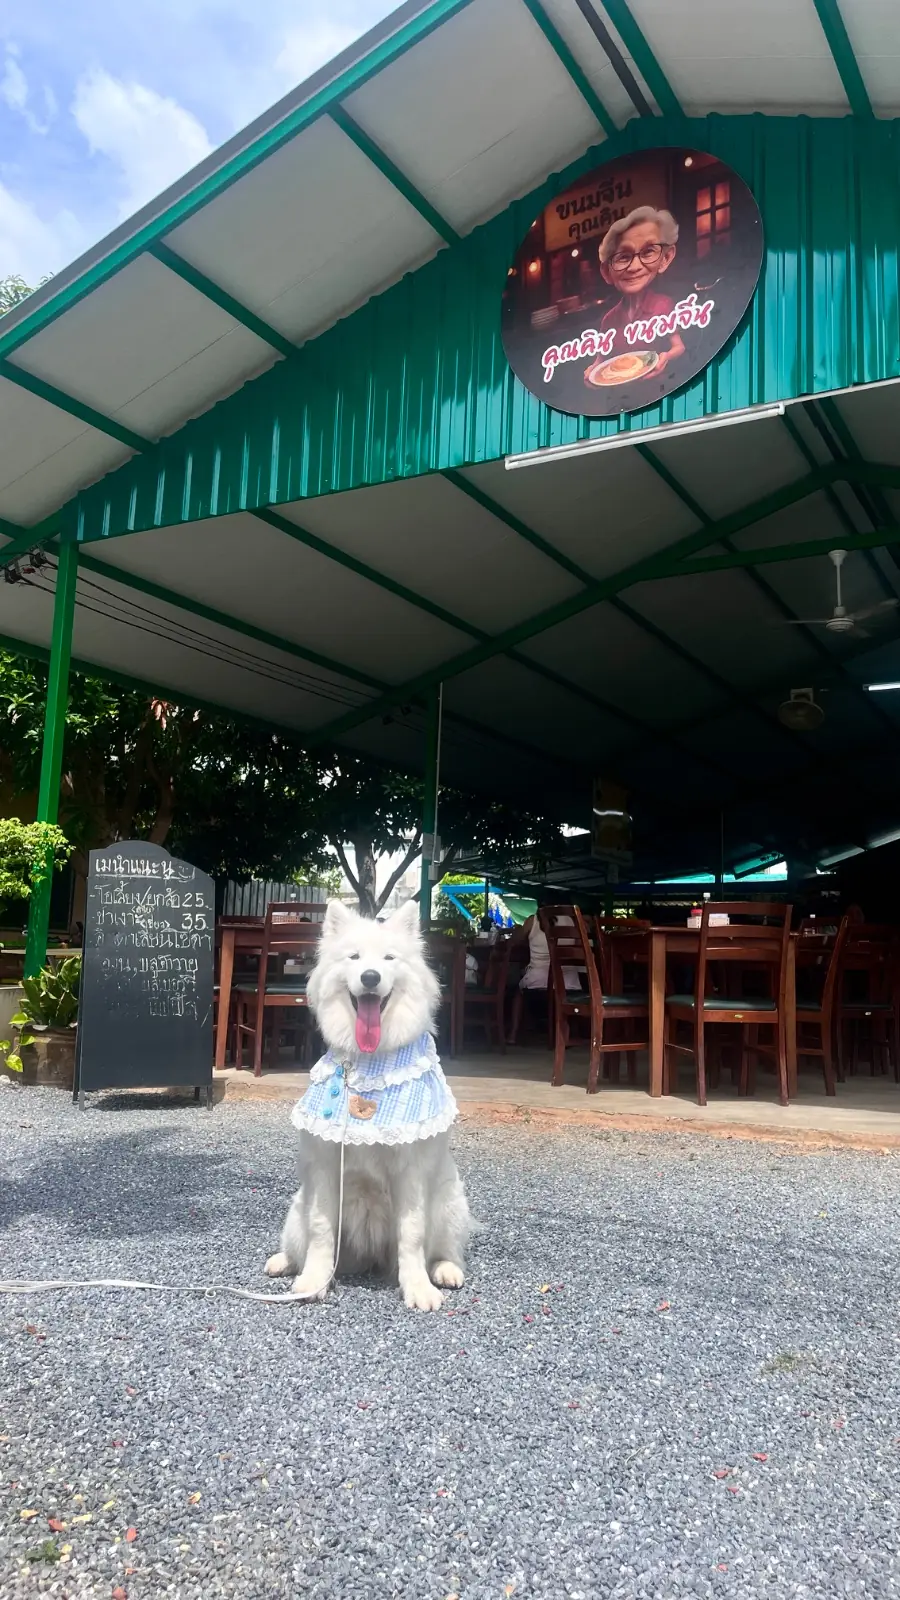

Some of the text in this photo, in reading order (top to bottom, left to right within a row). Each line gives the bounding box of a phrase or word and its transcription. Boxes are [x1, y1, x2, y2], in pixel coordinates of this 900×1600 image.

[556, 177, 634, 220] ขนมจีน
[624, 293, 715, 344] ขนมจีน
